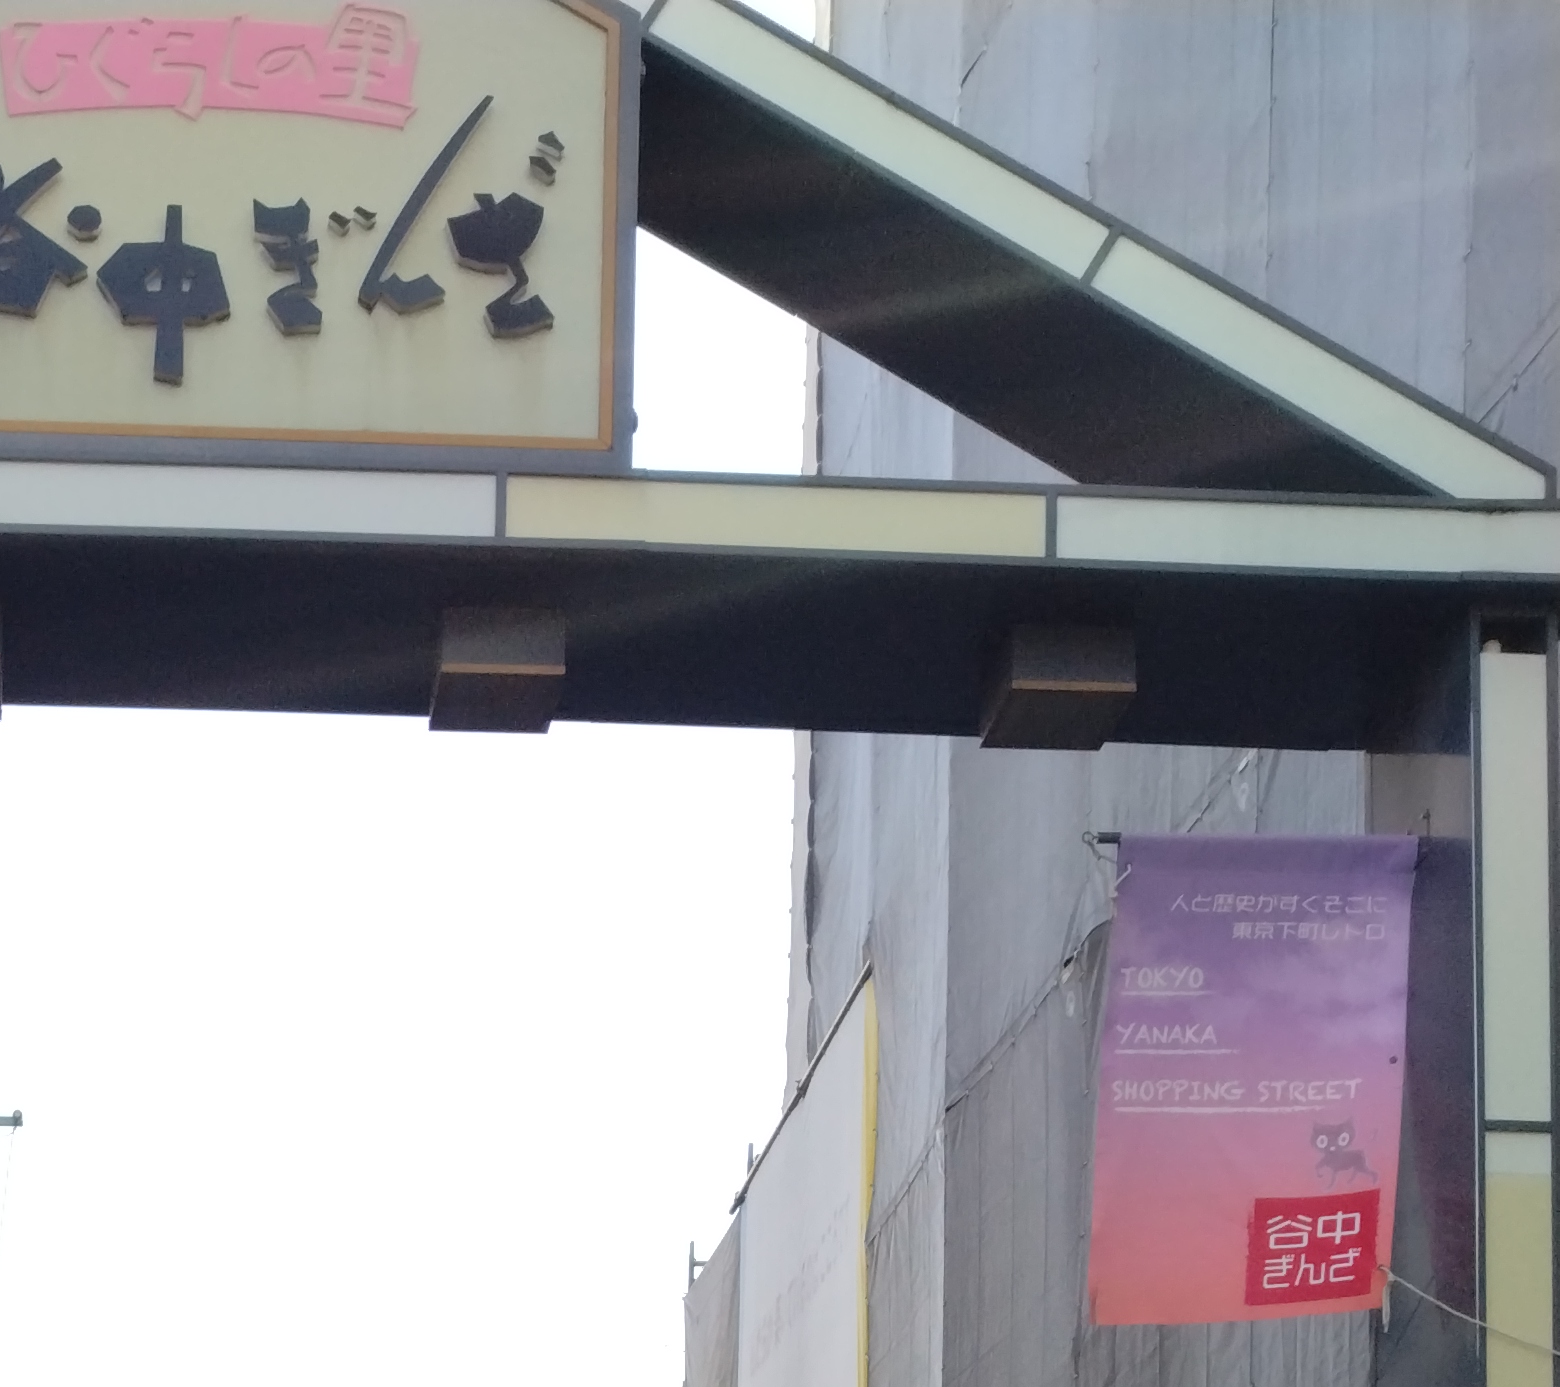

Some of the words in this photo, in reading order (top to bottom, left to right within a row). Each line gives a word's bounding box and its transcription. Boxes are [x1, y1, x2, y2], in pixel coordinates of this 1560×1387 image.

[10, 3, 414, 120] ひぐらしの里
[1231, 920, 1386, 942] 東京下町レトロ
[1120, 966, 1205, 990] TOKYO
[1114, 1023, 1219, 1046] YANAKA
[1110, 1079, 1246, 1102] SHOPPING
[1257, 1078, 1364, 1102] STREET
[1265, 1209, 1362, 1250] 谷中
[1262, 1248, 1364, 1290] ぎんざ
